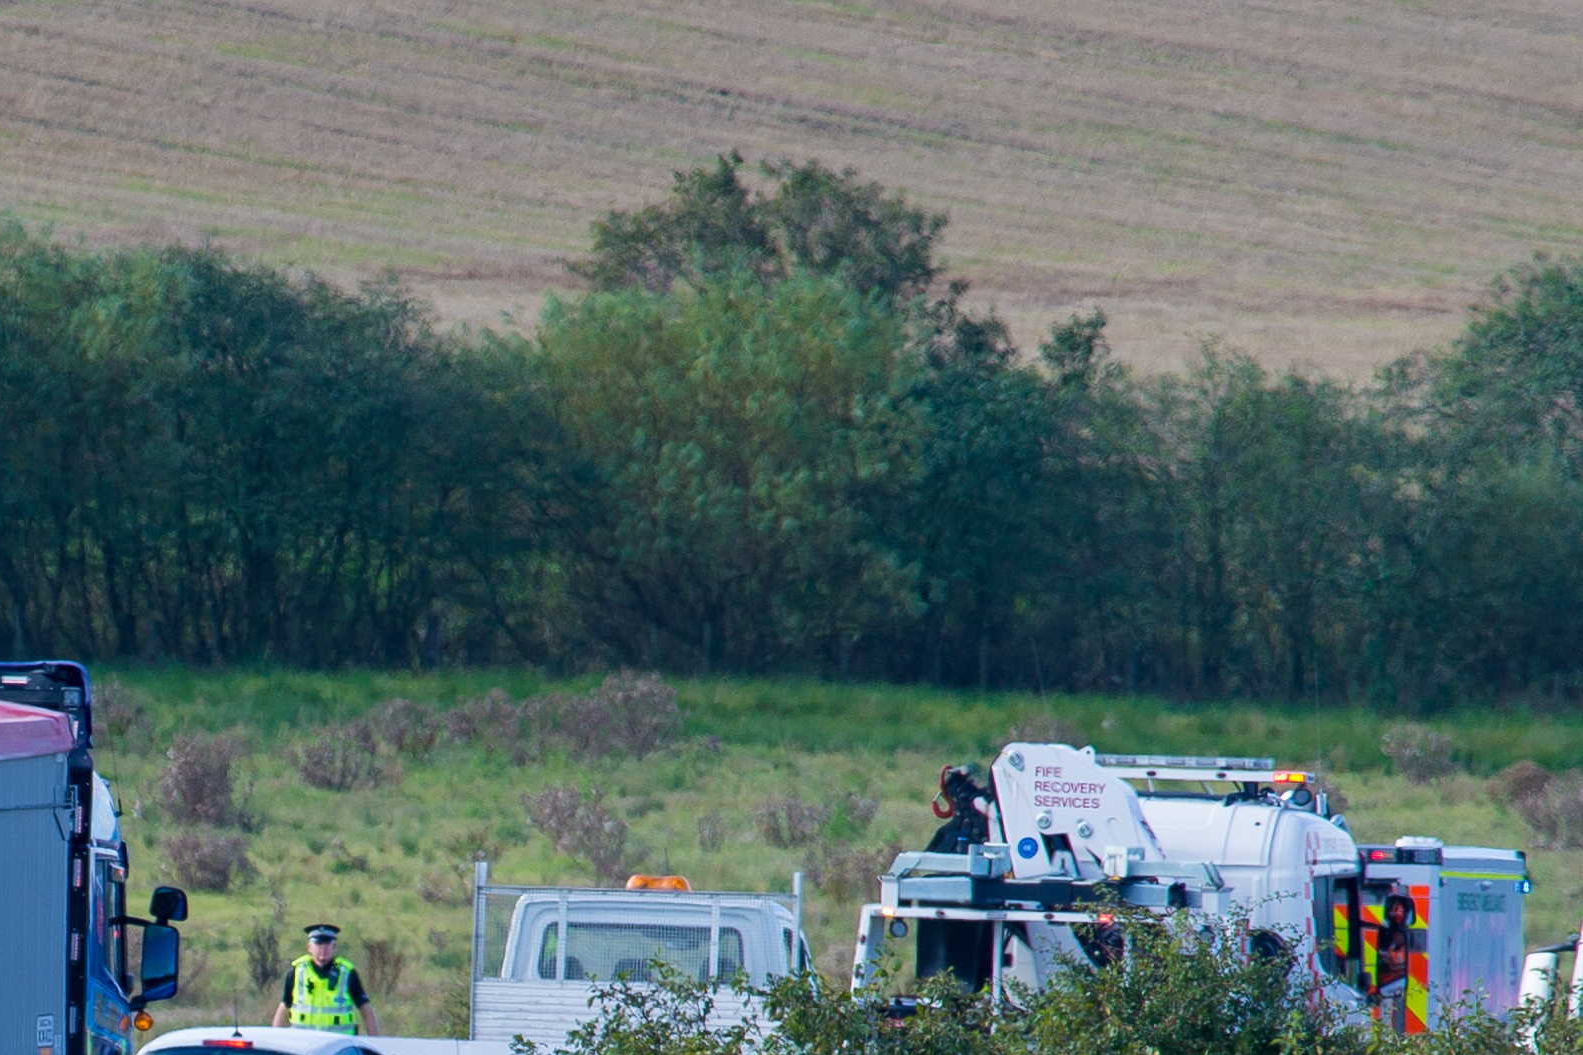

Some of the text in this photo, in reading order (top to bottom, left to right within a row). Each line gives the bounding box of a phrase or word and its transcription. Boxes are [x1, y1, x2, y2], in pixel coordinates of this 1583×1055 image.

[1035, 766, 1062, 778] FIFE
[1034, 780, 1106, 795] RECOVERY
[1034, 795, 1100, 809] SERVICES
